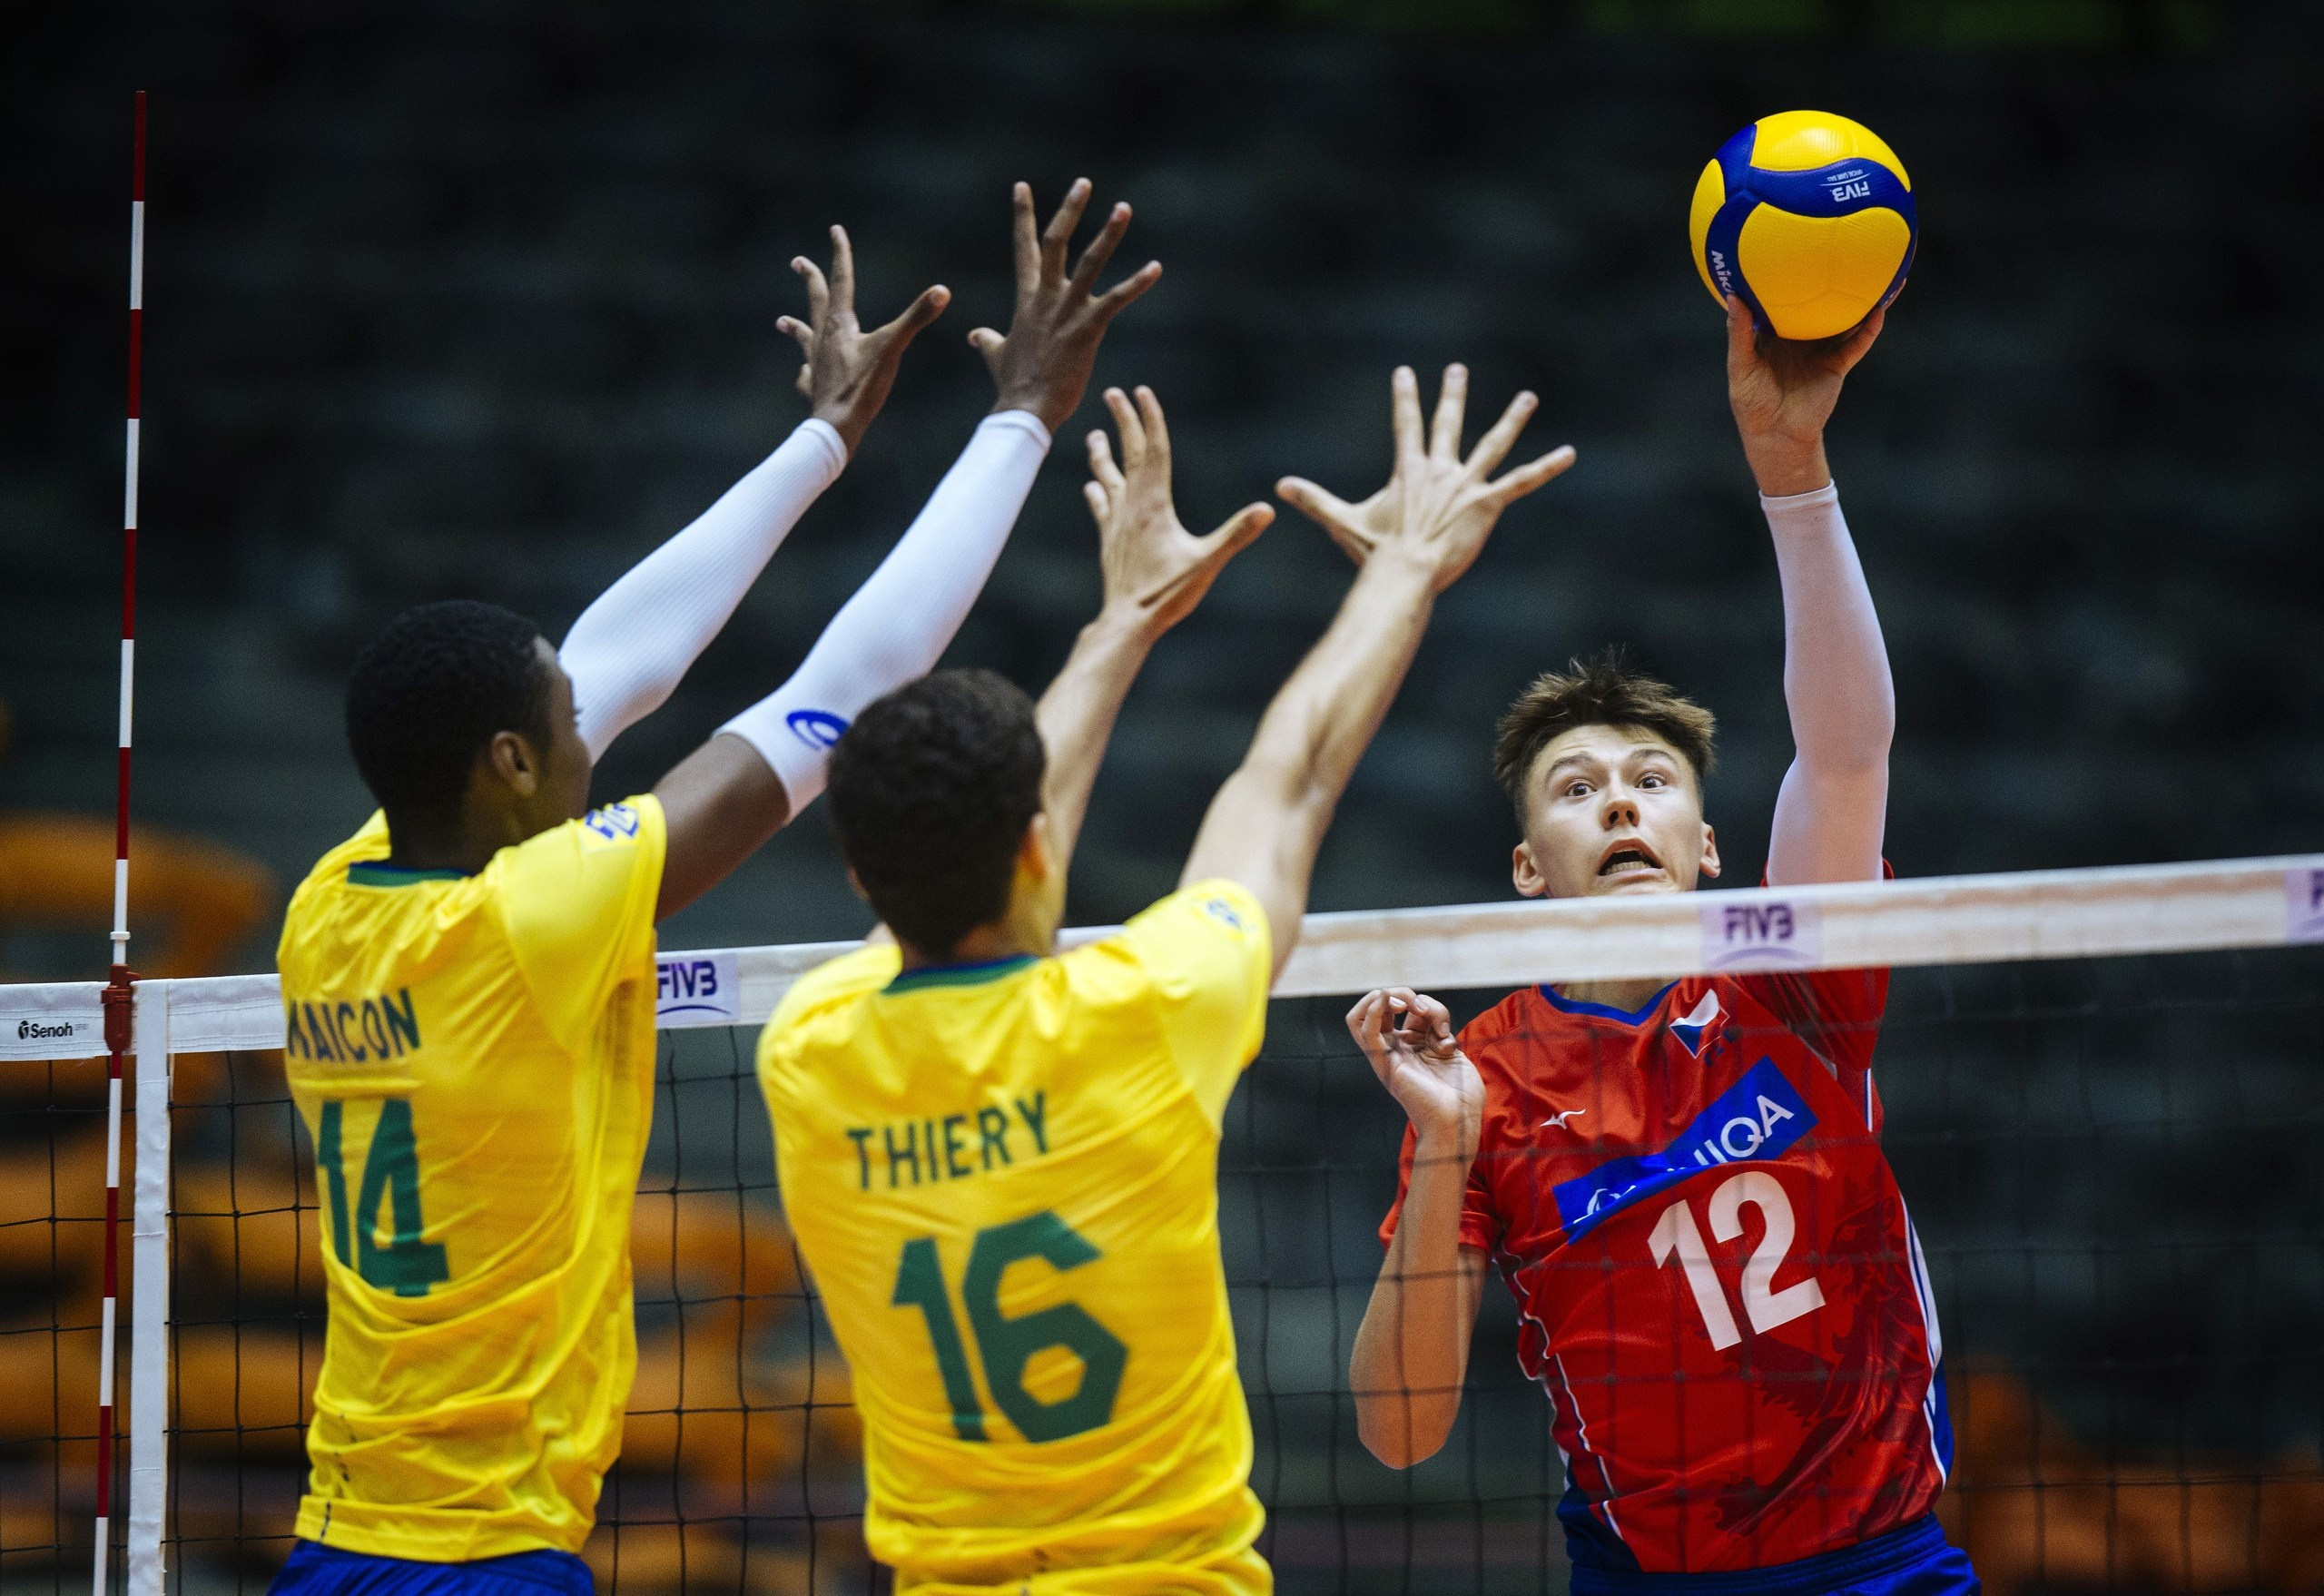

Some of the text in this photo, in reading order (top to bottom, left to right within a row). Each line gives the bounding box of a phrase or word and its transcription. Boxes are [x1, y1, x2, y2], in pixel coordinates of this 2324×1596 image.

[1832, 181, 1870, 202] FIVB
[1724, 901, 1795, 941] FIVB
[656, 960, 718, 1000] FIVB
[30, 1021, 73, 1039] Senoh
[845, 1089, 1049, 1192] THIERY
[1666, 1094, 1795, 1173] IQA
[318, 1099, 450, 1296] 14
[1647, 1170, 1827, 1352] 12
[891, 1210, 1131, 1444] 16
